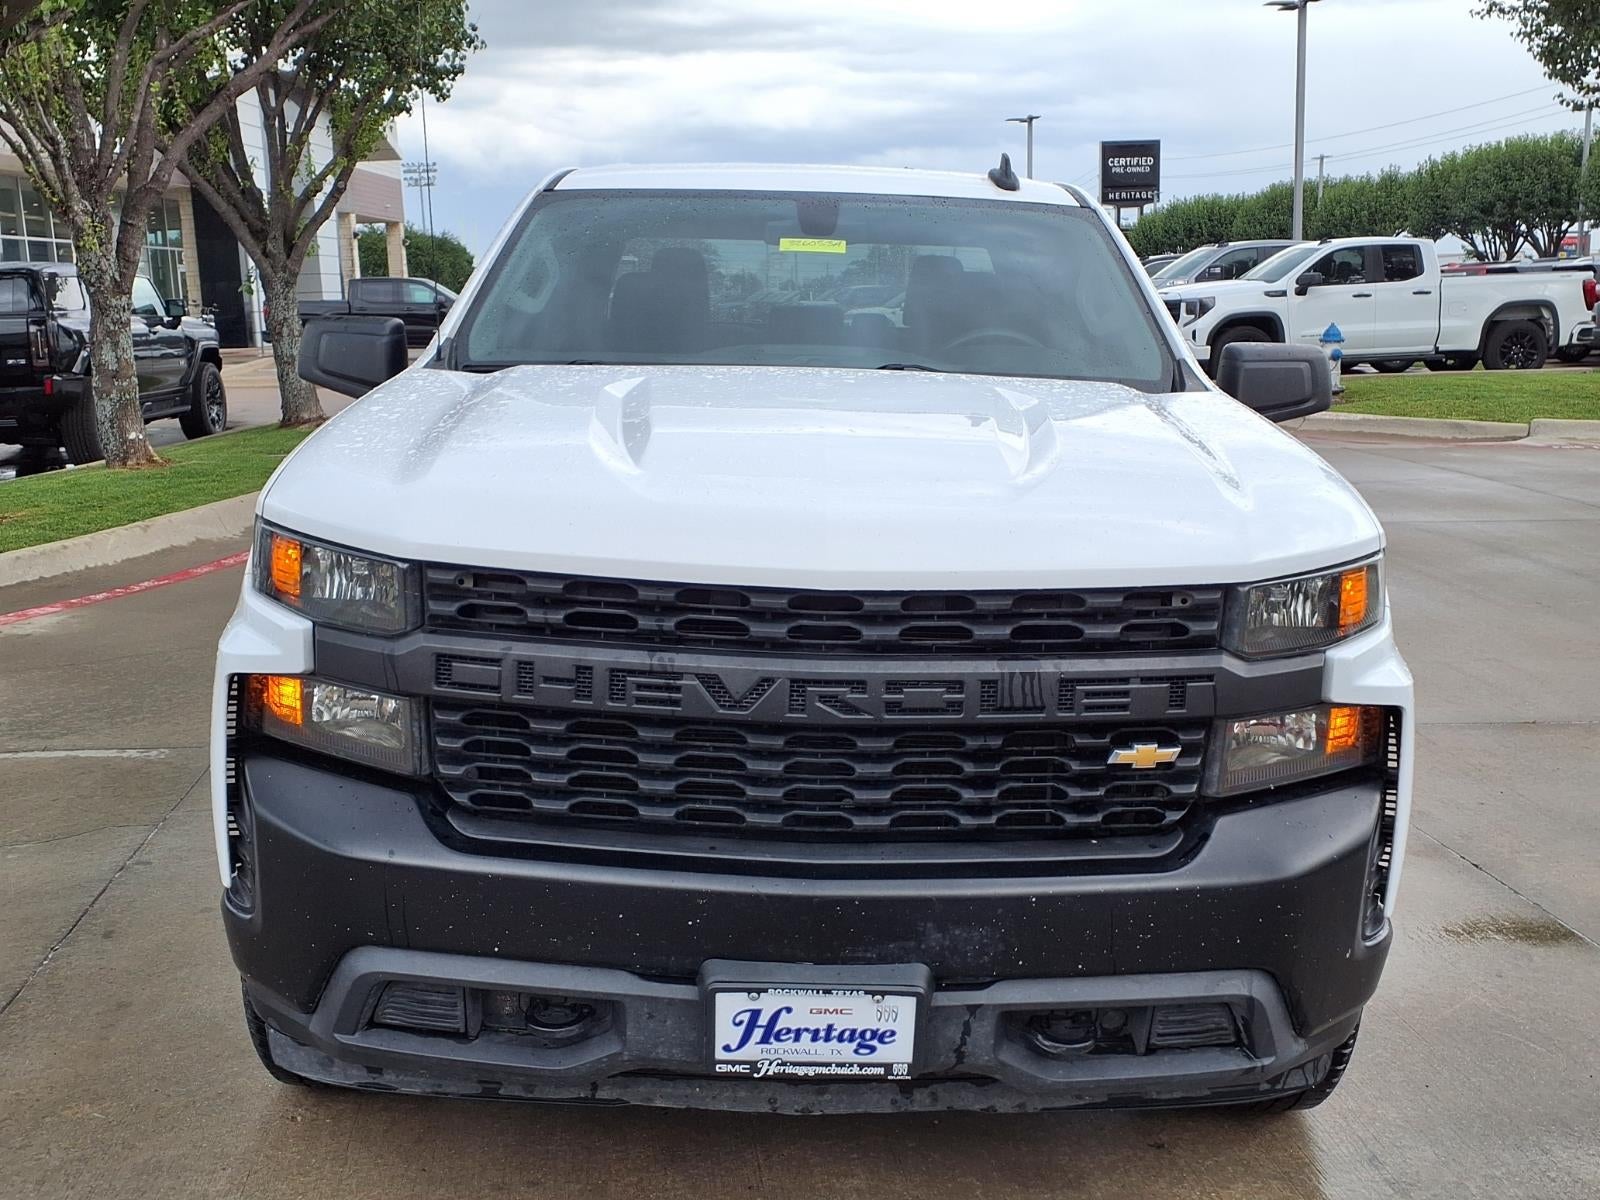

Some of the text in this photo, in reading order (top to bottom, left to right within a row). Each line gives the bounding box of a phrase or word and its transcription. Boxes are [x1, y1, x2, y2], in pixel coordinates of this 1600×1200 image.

[1108, 157, 1154, 166] CERTIFIED
[1108, 191, 1153, 199] HERITAGE
[432, 652, 1215, 717] CHEVROLET
[721, 1006, 897, 1056] Heritage
[830, 1048, 843, 1056] TX
[715, 1063, 751, 1073] GMC
[753, 1058, 885, 1078] Heritagegmcbuick.com
